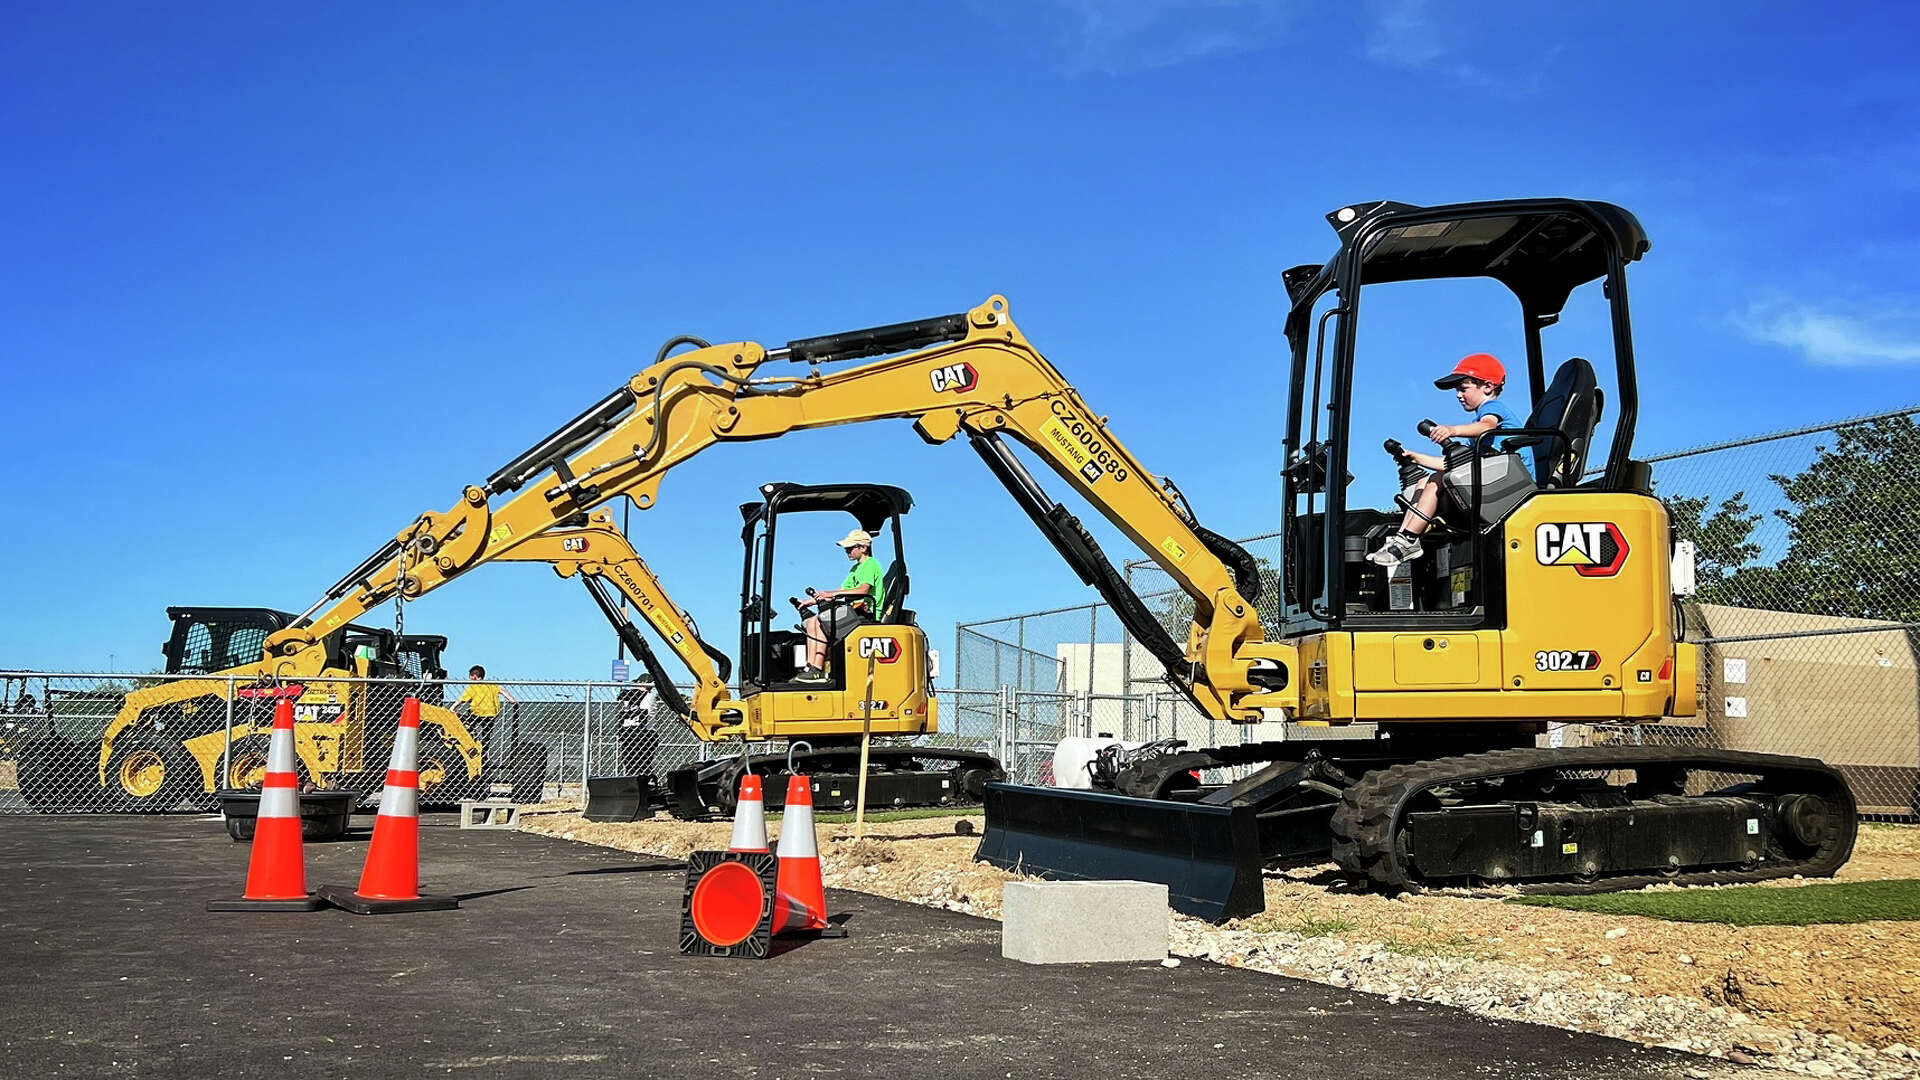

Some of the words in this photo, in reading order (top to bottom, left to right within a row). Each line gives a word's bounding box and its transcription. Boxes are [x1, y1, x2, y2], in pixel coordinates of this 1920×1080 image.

[930, 363, 967, 392] CAT
[1050, 400, 1128, 483] CZ600689
[1051, 428, 1084, 464] MUSTANG
[1082, 464, 1101, 481] CAT
[563, 538, 584, 551] CAT
[1536, 523, 1606, 565] CAT
[614, 565, 654, 611] CZ600701
[860, 638, 892, 658] CAT
[1536, 651, 1590, 671] 302.7
[294, 705, 320, 721] CAT
[859, 701, 884, 710] 32.7
